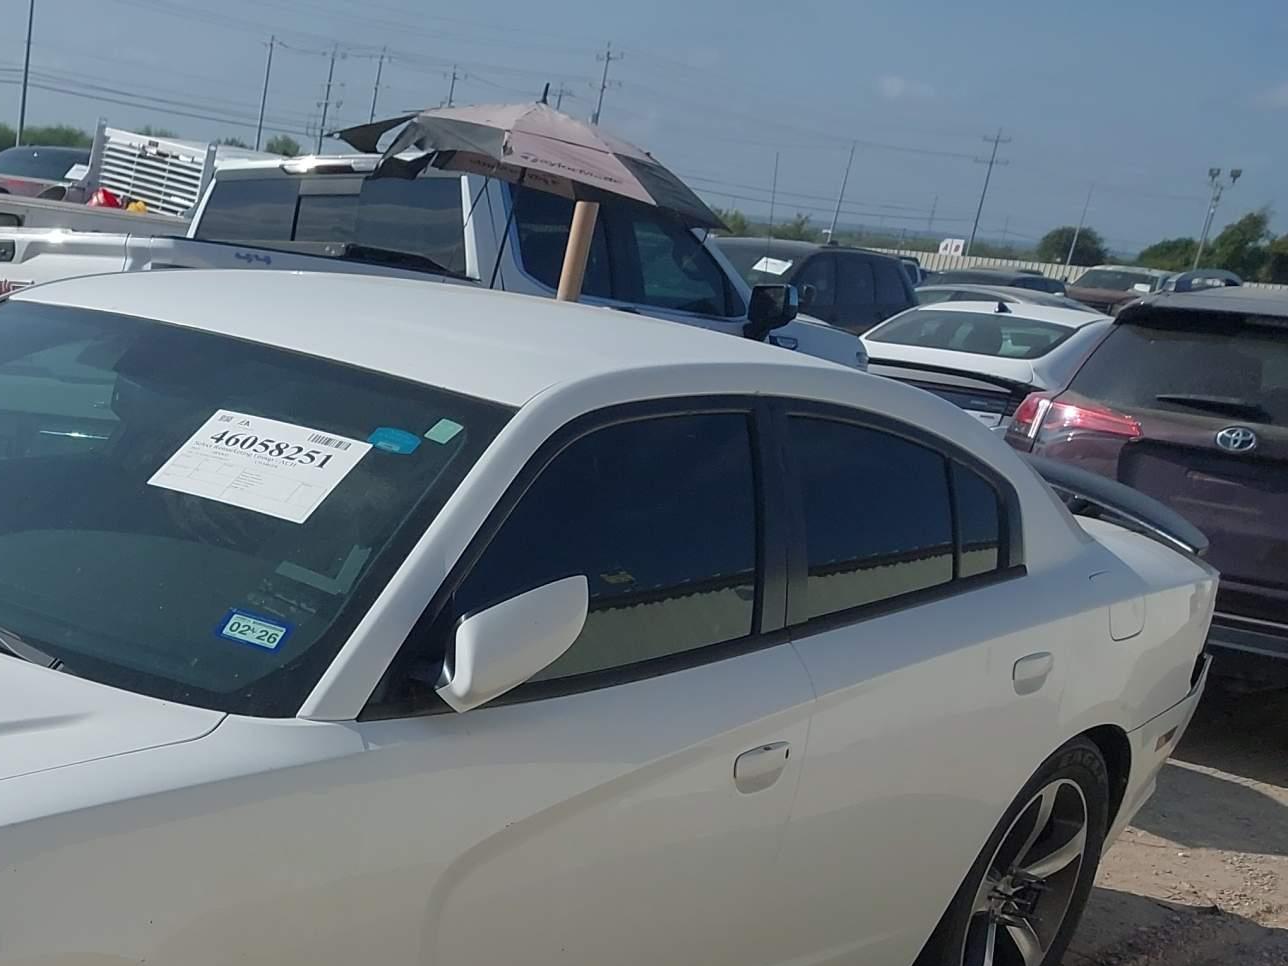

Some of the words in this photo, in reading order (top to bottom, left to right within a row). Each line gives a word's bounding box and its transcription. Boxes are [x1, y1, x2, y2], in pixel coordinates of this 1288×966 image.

[210, 430, 333, 468] 46058251
[229, 621, 252, 636] 02
[255, 629, 280, 644] 26
